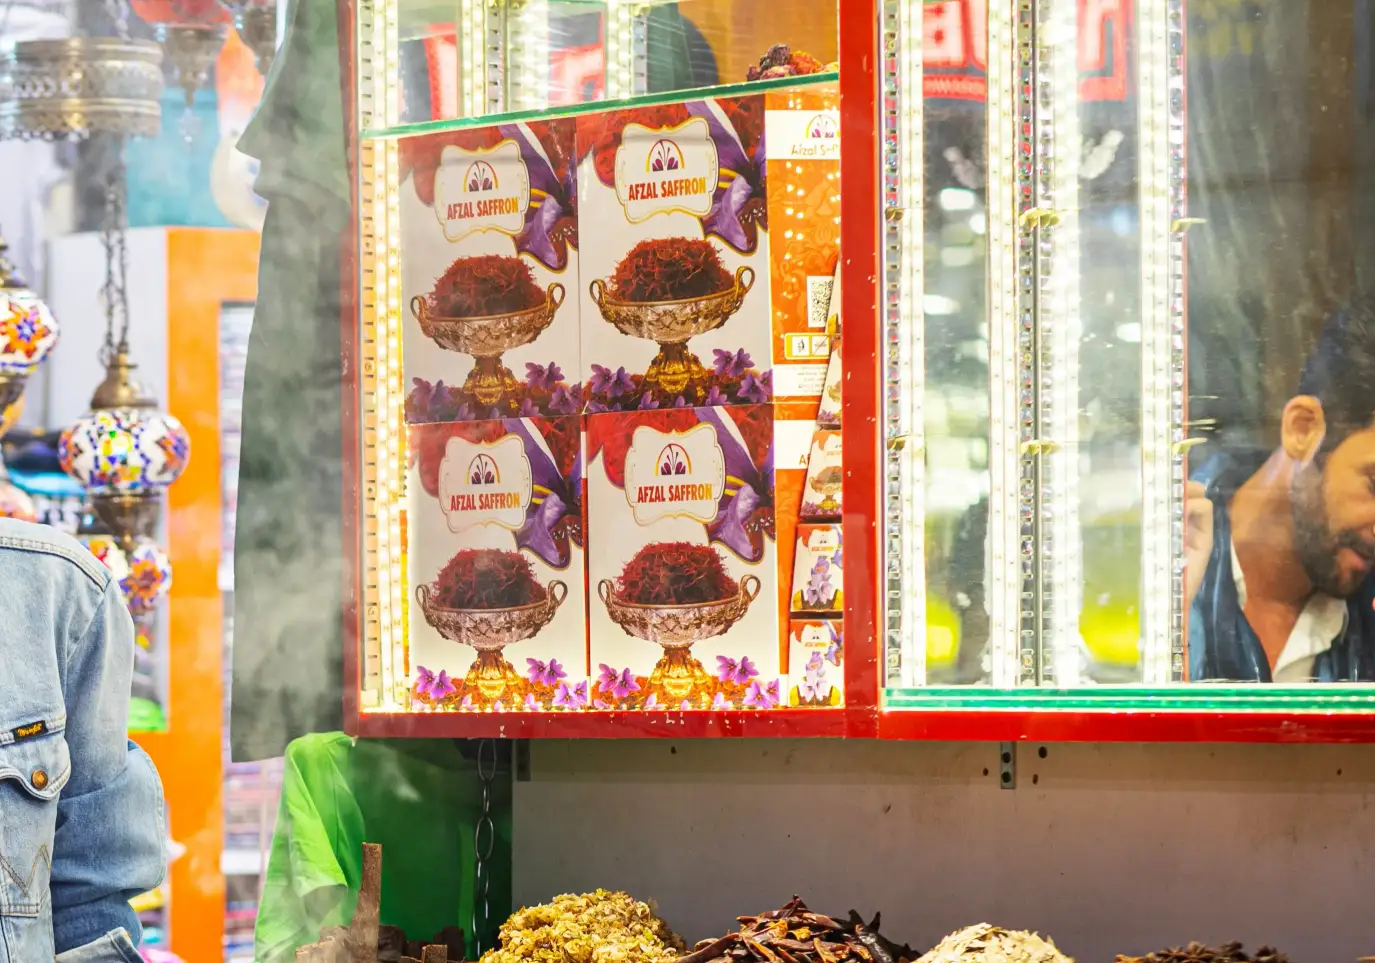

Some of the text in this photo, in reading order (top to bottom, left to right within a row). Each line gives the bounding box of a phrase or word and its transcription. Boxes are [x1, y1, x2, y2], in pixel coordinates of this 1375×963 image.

[628, 177, 706, 201] AFZAL SAFFRON
[447, 197, 519, 220] AFZAL SAFFRON
[450, 492, 520, 511] AFZAL SAFFRON
[637, 483, 712, 503] AFZAL SAFFRON
